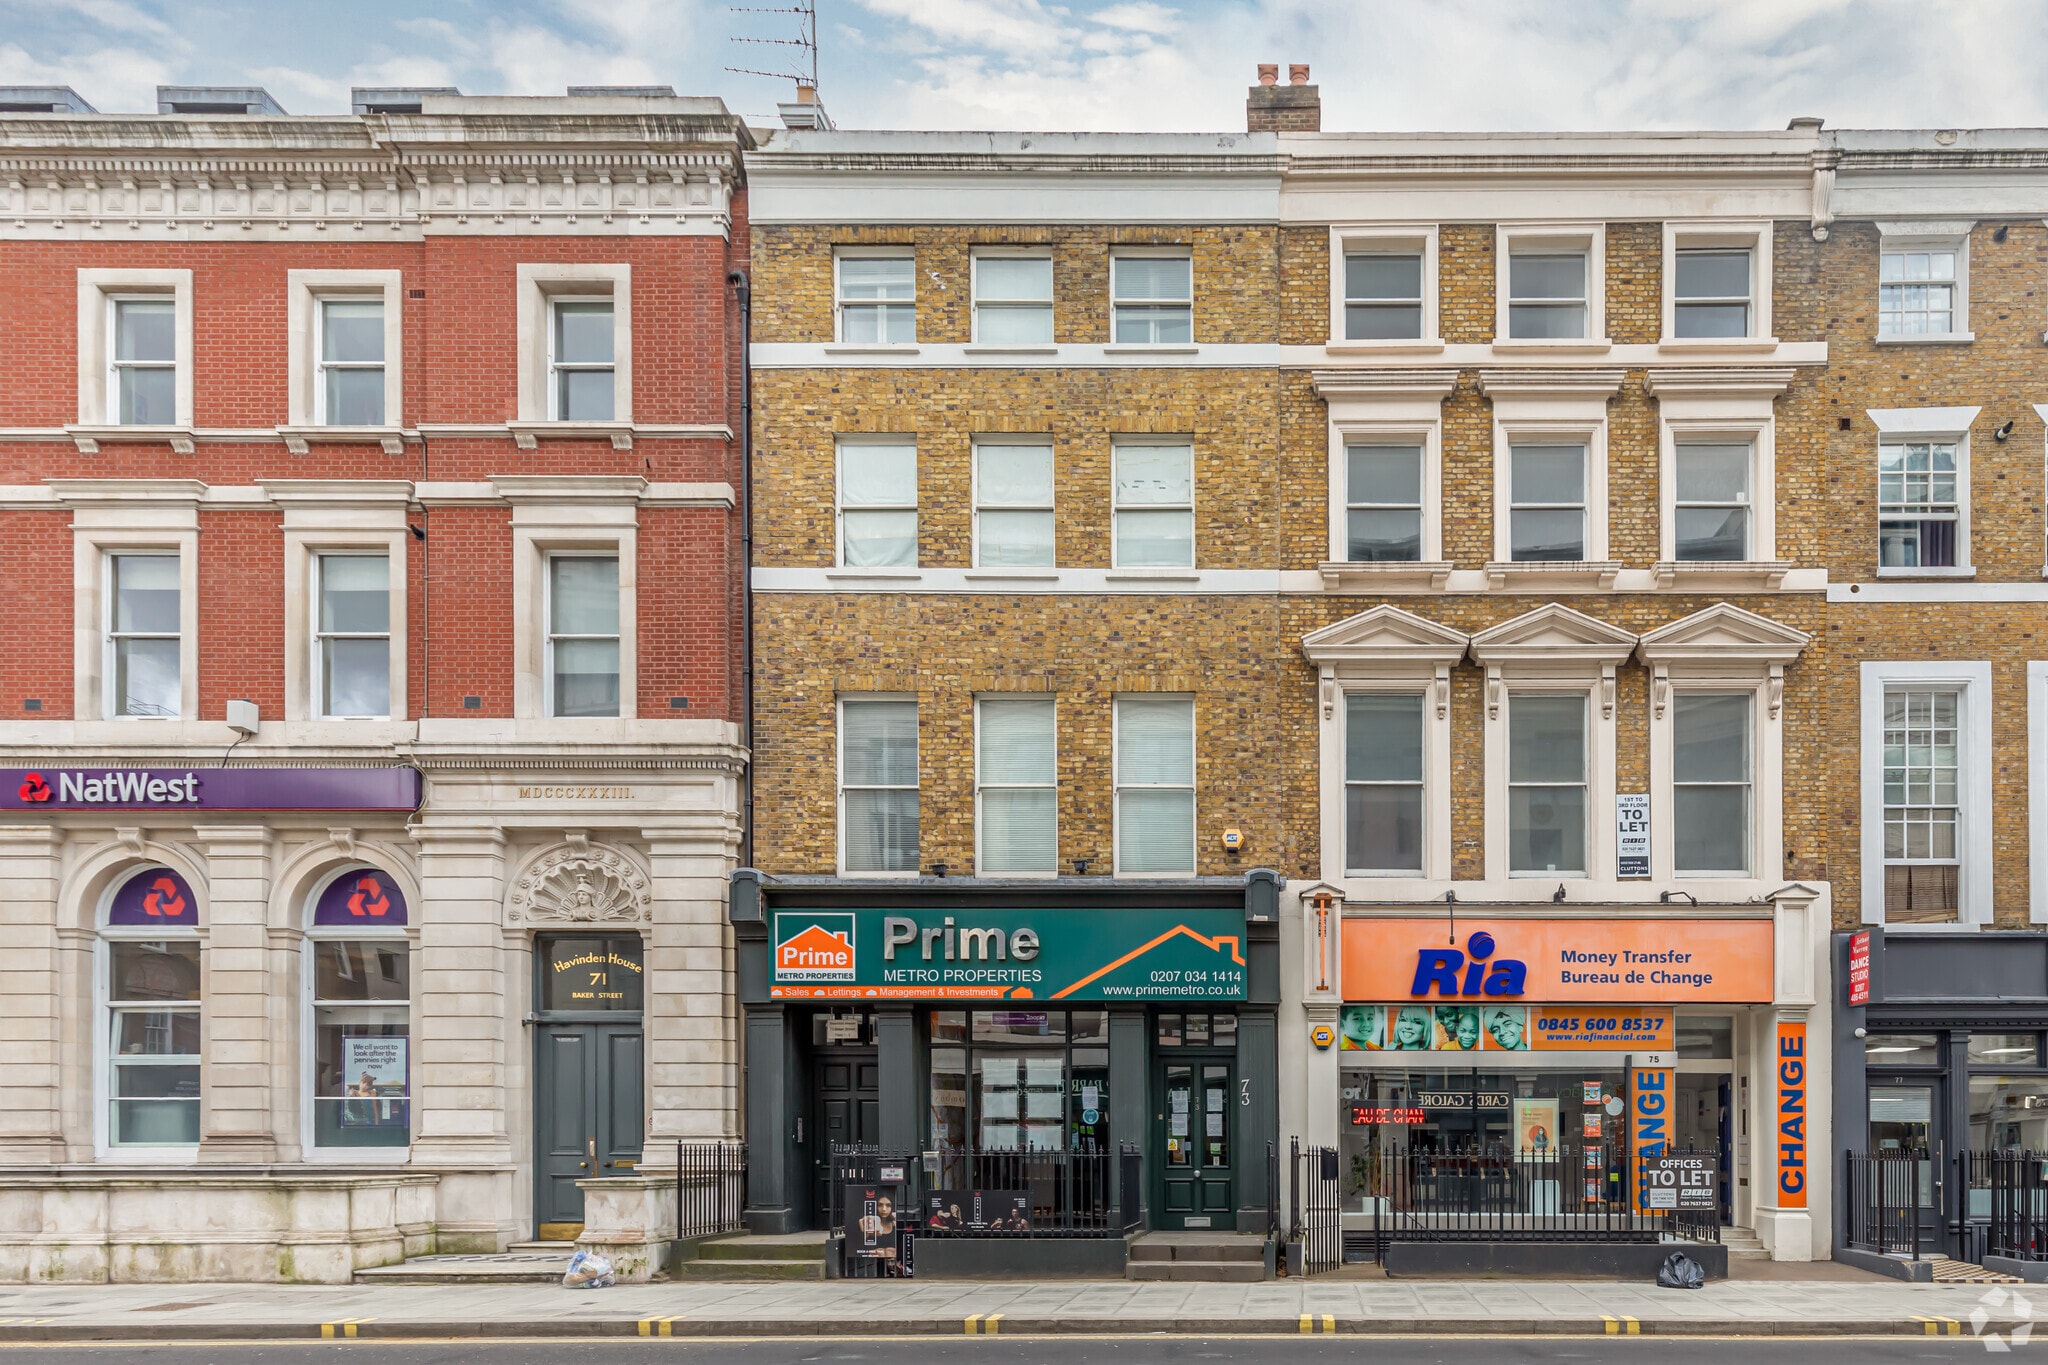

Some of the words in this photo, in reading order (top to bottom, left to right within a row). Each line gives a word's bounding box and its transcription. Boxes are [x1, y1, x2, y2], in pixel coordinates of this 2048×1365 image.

[60, 772, 198, 802] NatWest
[519, 787, 635, 799] MDCCCXXXIII.
[1622, 810, 1643, 820] TO
[1619, 822, 1648, 832] LET
[883, 916, 1040, 962] Prime
[553, 951, 606, 973] Havinden
[607, 952, 643, 974] House
[783, 947, 848, 966] Prime
[1560, 949, 1618, 966] Money
[1623, 948, 1692, 964] Transfer
[1850, 955, 1870, 971] DANCE
[1410, 931, 1528, 997] Ria
[589, 972, 607, 986] 71
[884, 969, 939, 982] METRO
[943, 969, 1042, 982] PROPERTIES
[1150, 970, 1181, 982] 0207
[1184, 970, 1208, 982] 034
[1212, 970, 1242, 982] 1414
[1561, 969, 1620, 985] Bureau
[1625, 969, 1645, 985] de
[1650, 969, 1713, 987] Change
[1850, 969, 1869, 983] STUDIO
[785, 988, 810, 996] Sales
[827, 988, 862, 998] Lettings
[880, 988, 936, 998] Management
[938, 988, 944, 996] &
[946, 988, 999, 996] Investments
[1103, 984, 1241, 997] www.primemetro.co.uk
[1537, 1018, 1580, 1031] 0845
[1584, 1018, 1619, 1031] 600
[1621, 1018, 1664, 1031] 8537
[1546, 1032, 1656, 1042] www.riafinancial.com
[1240, 1078, 1250, 1106] 73
[1780, 1036, 1804, 1195] CHANGE
[1660, 1160, 1703, 1168] OFFICES
[1648, 1170, 1676, 1186] TO
[1680, 1170, 1714, 1186] LET
